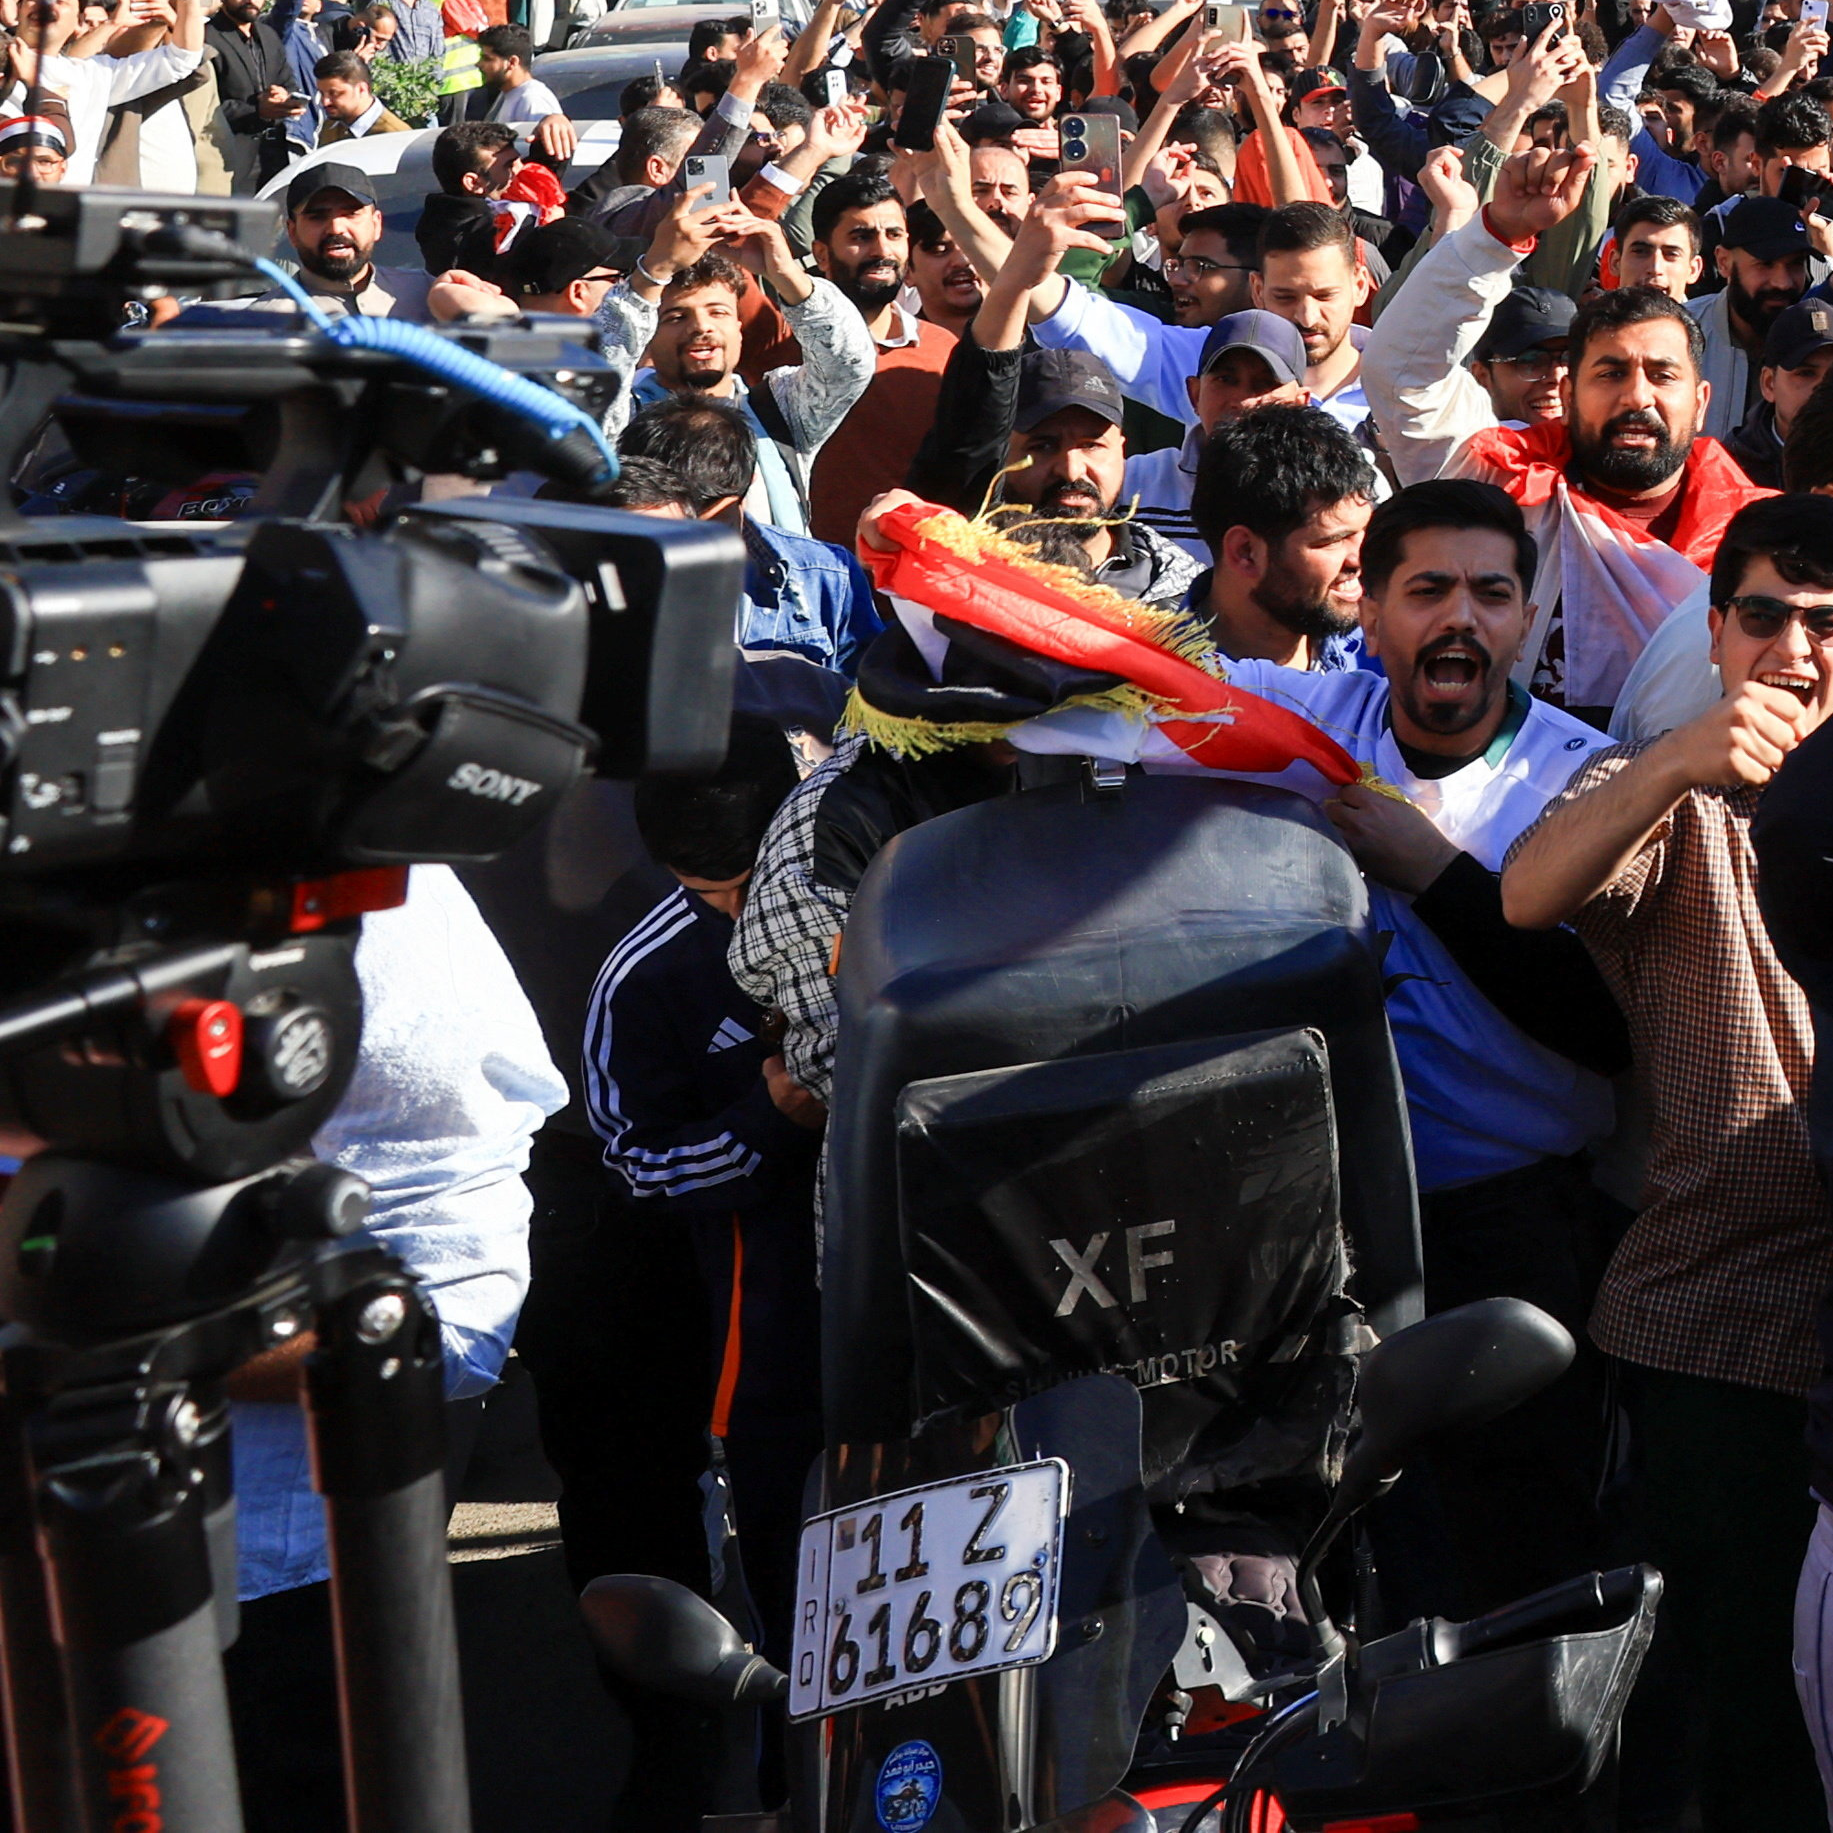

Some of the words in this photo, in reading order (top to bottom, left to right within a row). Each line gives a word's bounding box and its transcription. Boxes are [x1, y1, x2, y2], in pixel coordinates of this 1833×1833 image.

[445, 761, 544, 807] SONY
[1048, 1218, 1177, 1319] XF
[1136, 1339, 1240, 1385] MOTOR
[856, 1501, 930, 1595] 11
[962, 1482, 1010, 1567] Z
[799, 1548, 819, 1687] IRQ
[828, 1569, 1044, 1697] 61689
